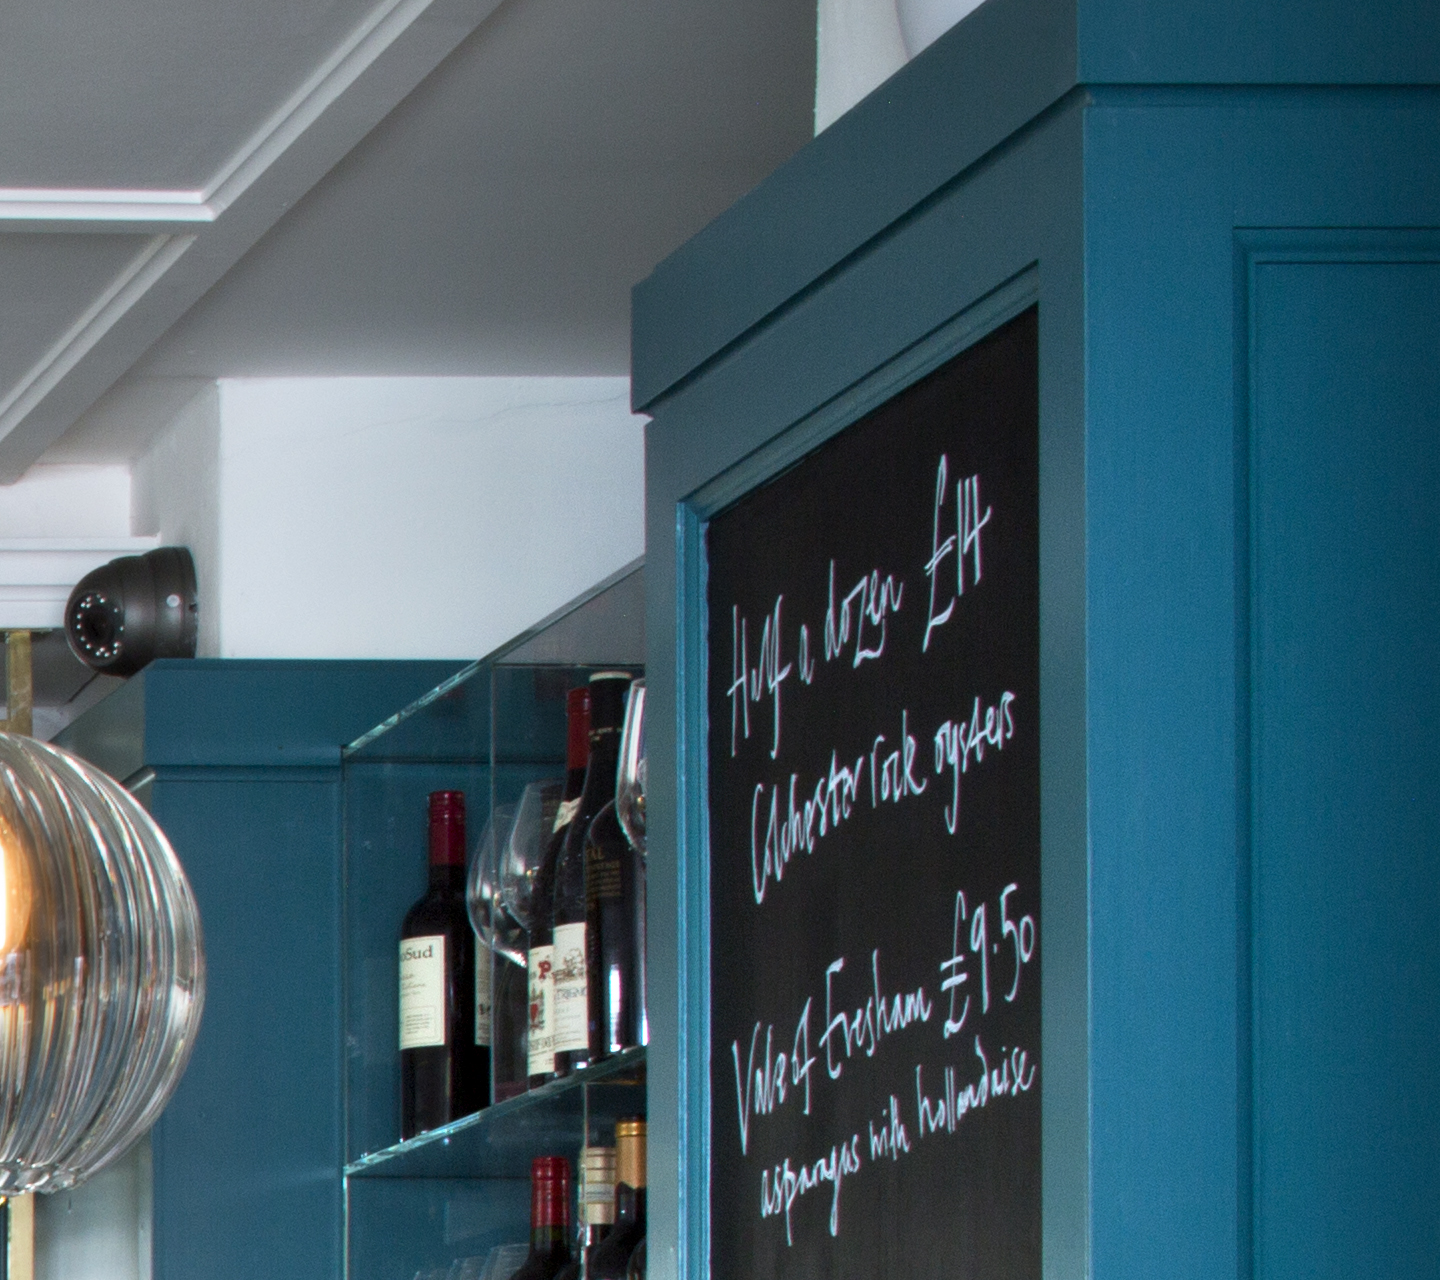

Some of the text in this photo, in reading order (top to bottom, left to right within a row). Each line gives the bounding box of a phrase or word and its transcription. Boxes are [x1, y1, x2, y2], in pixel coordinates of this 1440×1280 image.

[726, 453, 992, 761] Half a dozen £14
[750, 691, 1016, 906] Colchester rock oysters
[731, 1021, 789, 1156] Vale
[790, 996, 816, 1116] of
[939, 882, 1035, 1040] £9.50
[760, 1034, 1036, 1247] asparagus with hollandaise
